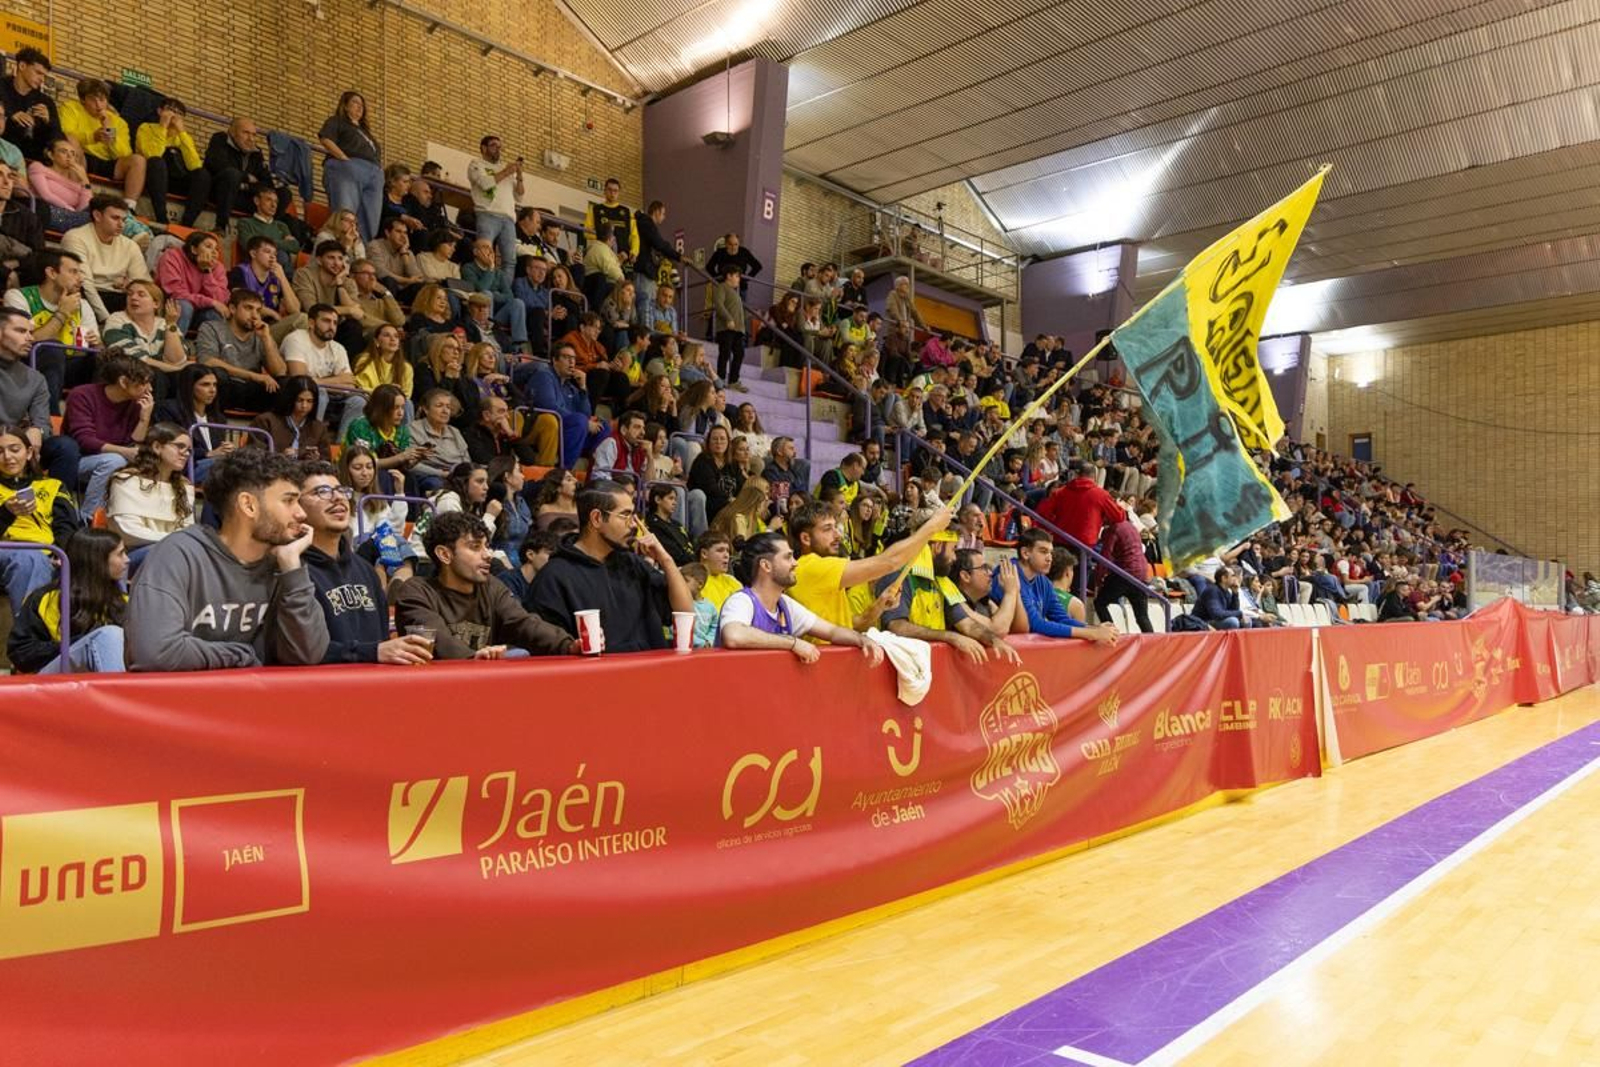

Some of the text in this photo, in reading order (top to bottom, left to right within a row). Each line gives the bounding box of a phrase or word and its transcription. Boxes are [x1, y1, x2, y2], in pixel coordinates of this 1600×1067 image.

[122, 68, 152, 84] SALIDA
[763, 198, 774, 220] B
[477, 763, 625, 849] Jaén
[851, 778, 942, 811] Ayuntamiento
[871, 801, 926, 829] de Jaén
[223, 844, 264, 872] JAÉN
[480, 826, 667, 879] PARAÍSO INTERIOR
[19, 854, 147, 907] UNED
